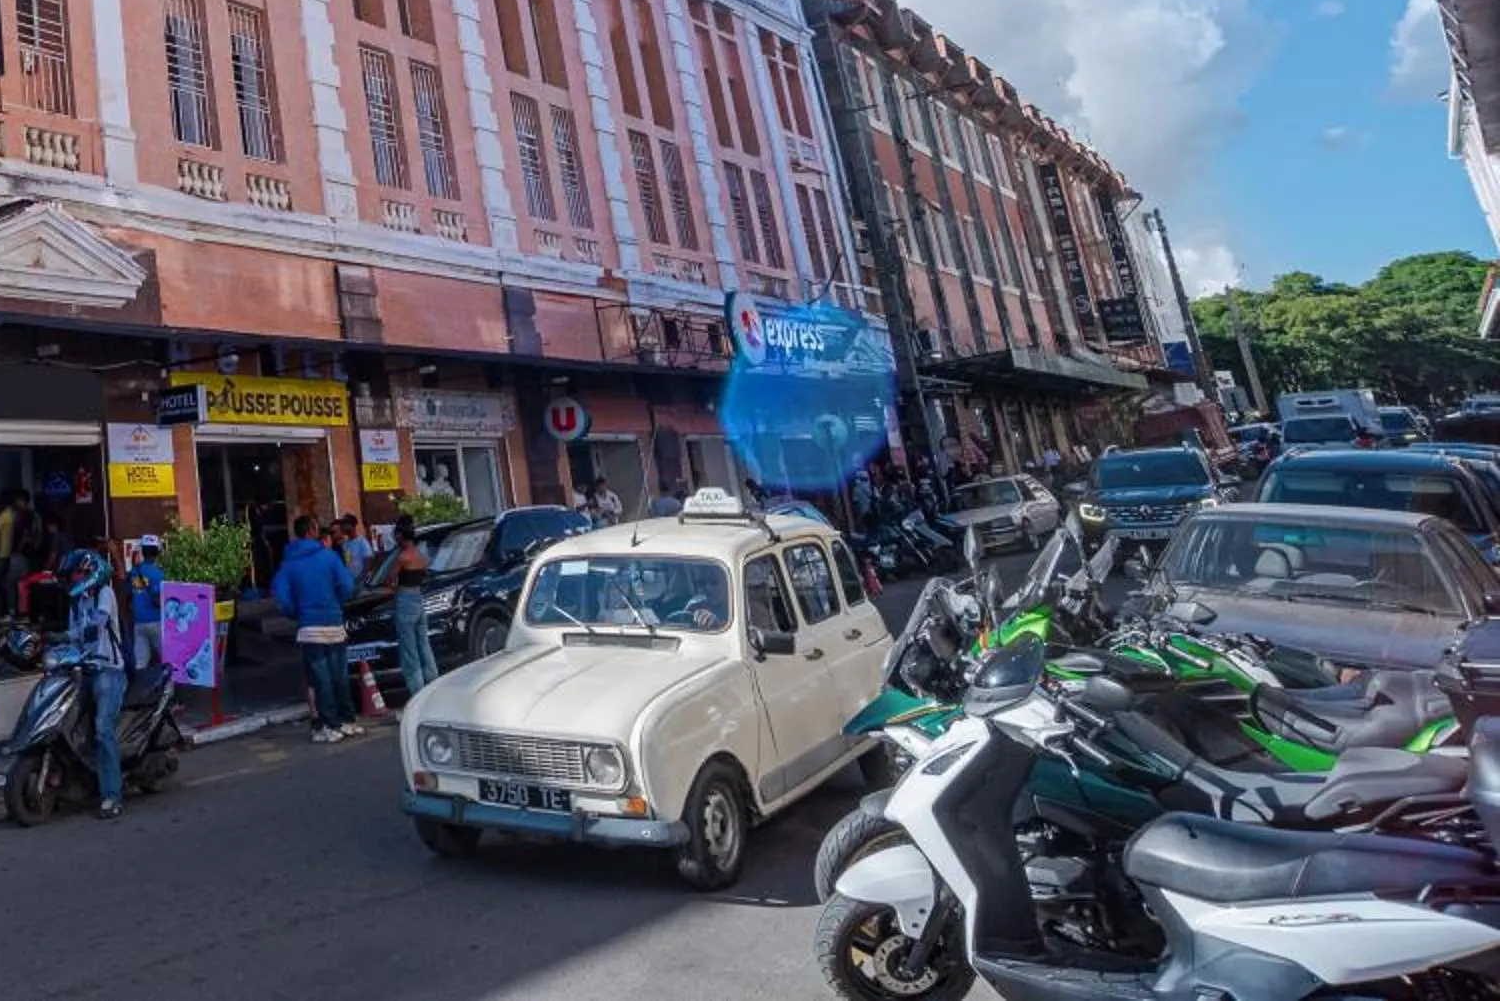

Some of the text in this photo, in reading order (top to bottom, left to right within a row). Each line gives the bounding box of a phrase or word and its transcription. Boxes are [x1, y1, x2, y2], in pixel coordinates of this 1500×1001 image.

[765, 318, 825, 358] express
[161, 394, 197, 408] HOTEL
[206, 390, 343, 418] PUSSE POUSSE
[551, 406, 577, 432] U
[700, 492, 722, 502] TAXI
[487, 782, 529, 805] 3750
